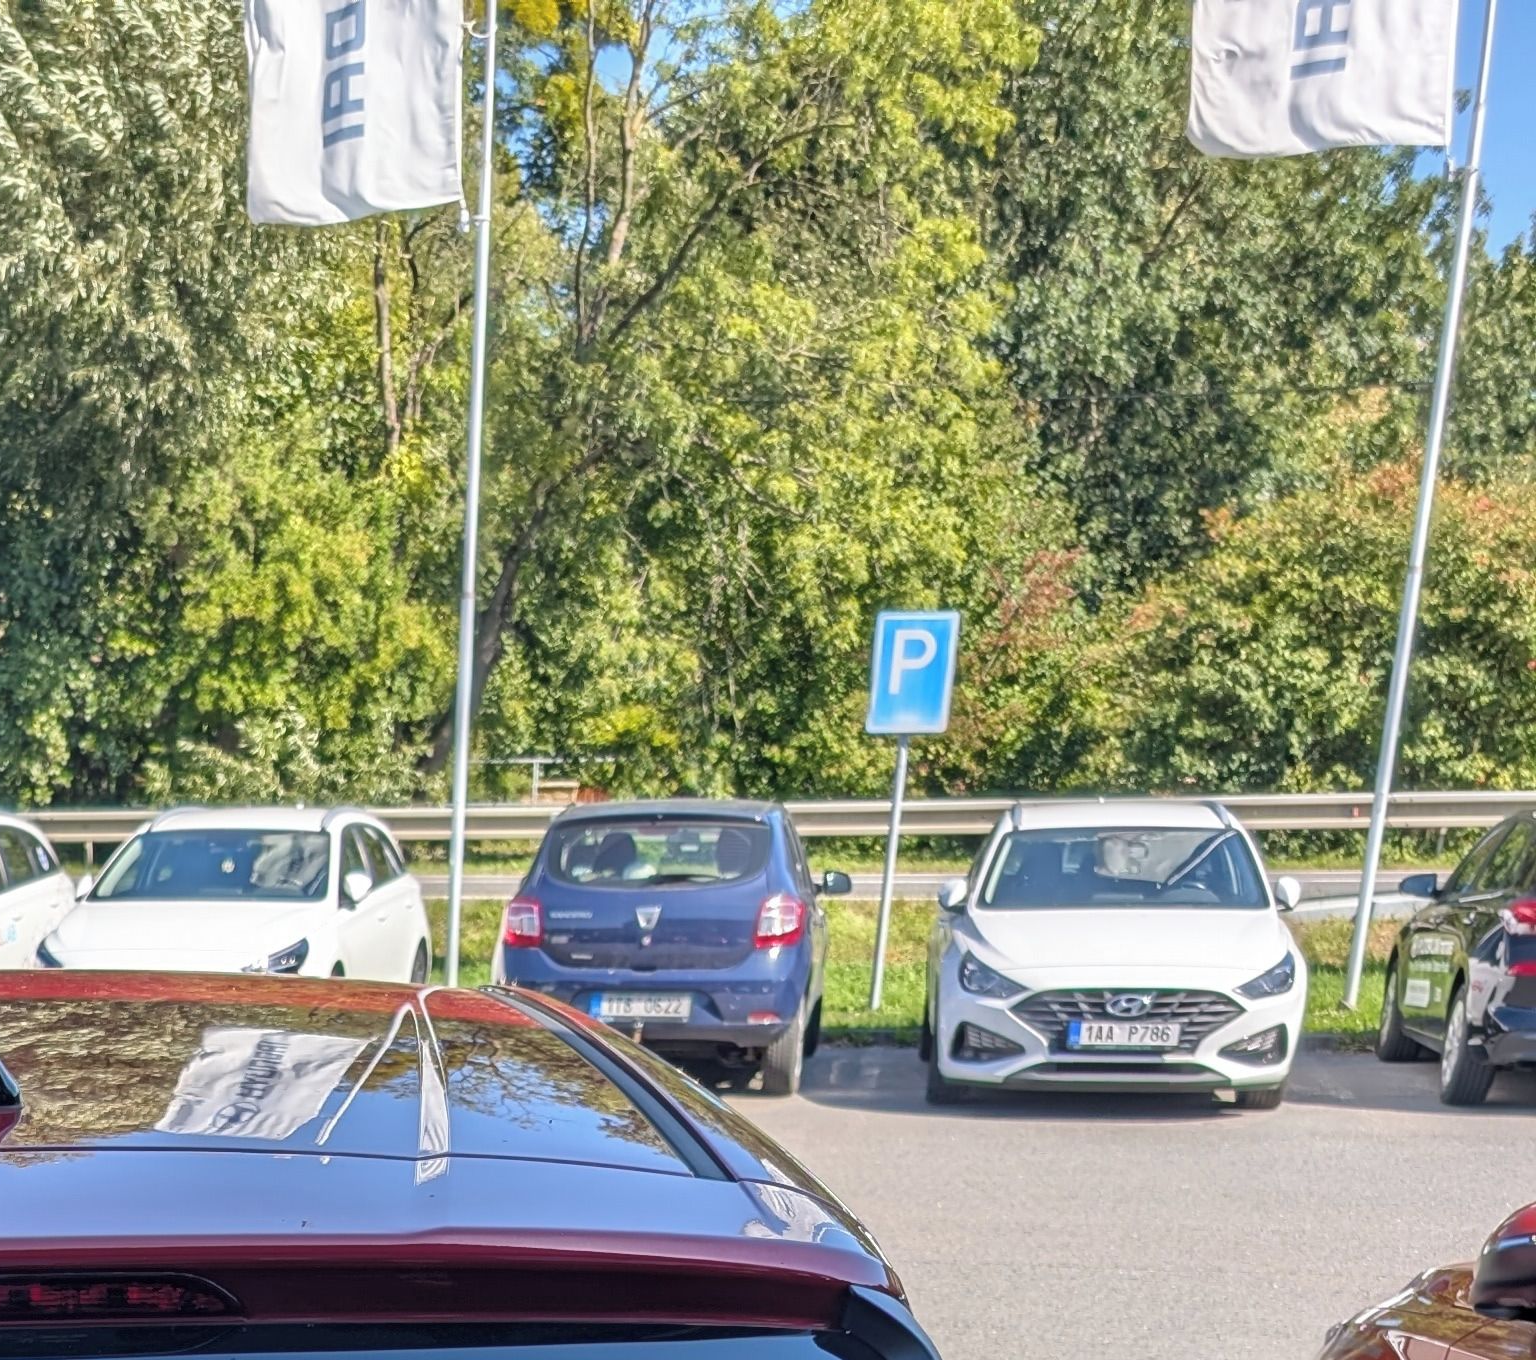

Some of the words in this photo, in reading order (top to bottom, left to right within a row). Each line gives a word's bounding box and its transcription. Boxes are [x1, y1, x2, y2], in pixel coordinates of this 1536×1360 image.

[888, 628, 938, 695] P
[1086, 1025, 1114, 1042] 1AA
[1128, 1025, 1172, 1043] P786
